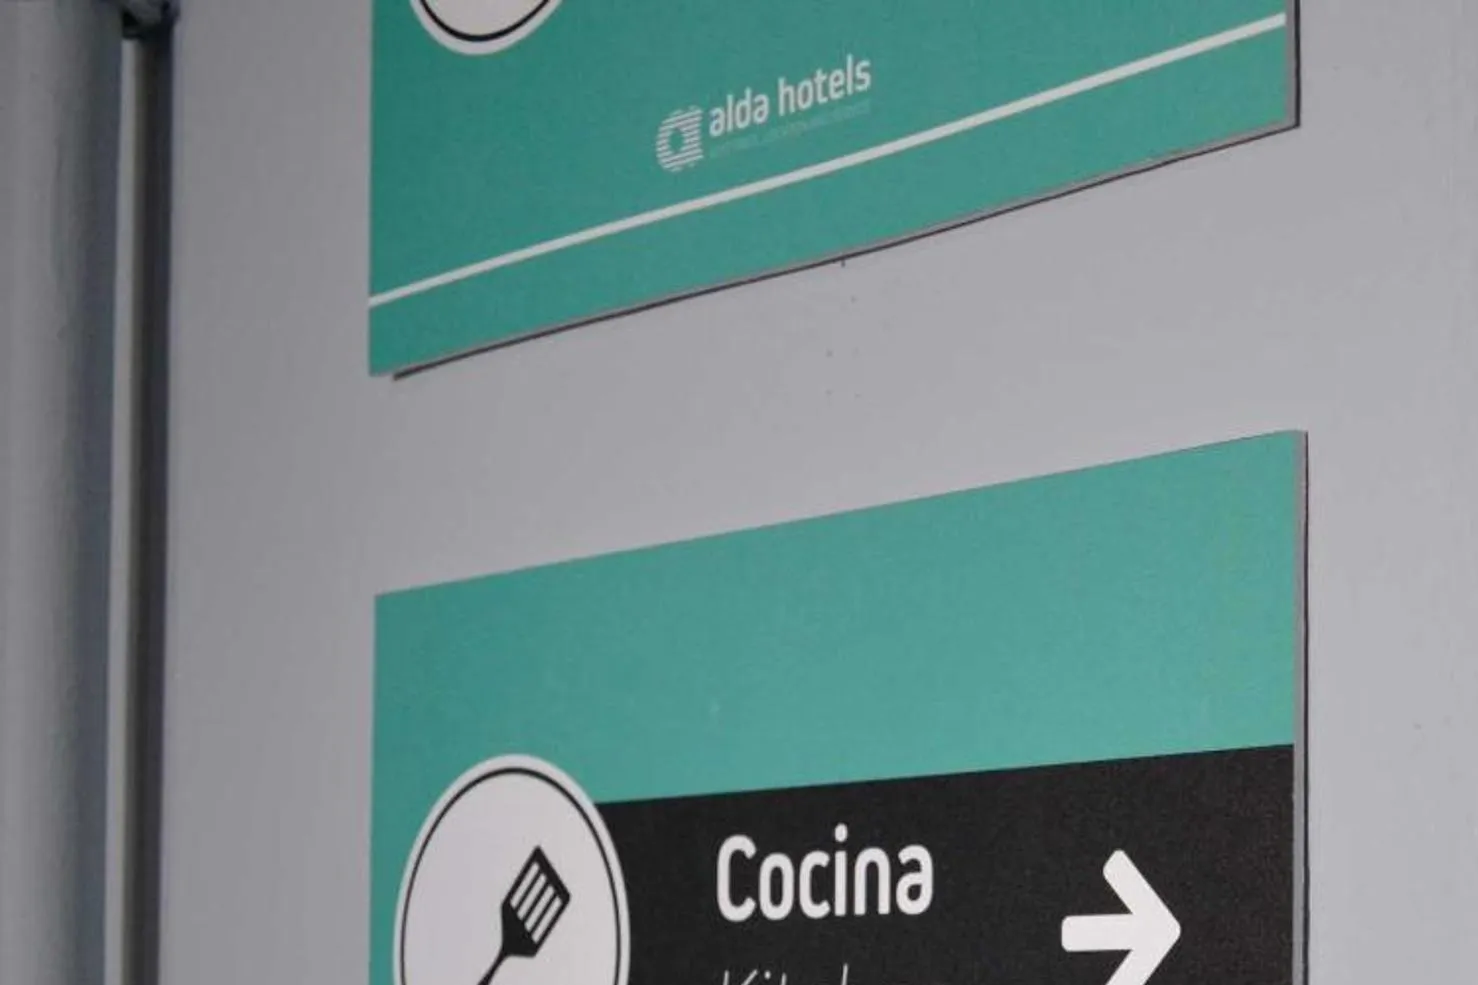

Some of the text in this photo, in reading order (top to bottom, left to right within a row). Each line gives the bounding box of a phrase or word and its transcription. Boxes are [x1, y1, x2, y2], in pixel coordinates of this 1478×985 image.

[709, 87, 769, 137] alda
[778, 53, 871, 116] hotels
[717, 823, 934, 922] Cocina
